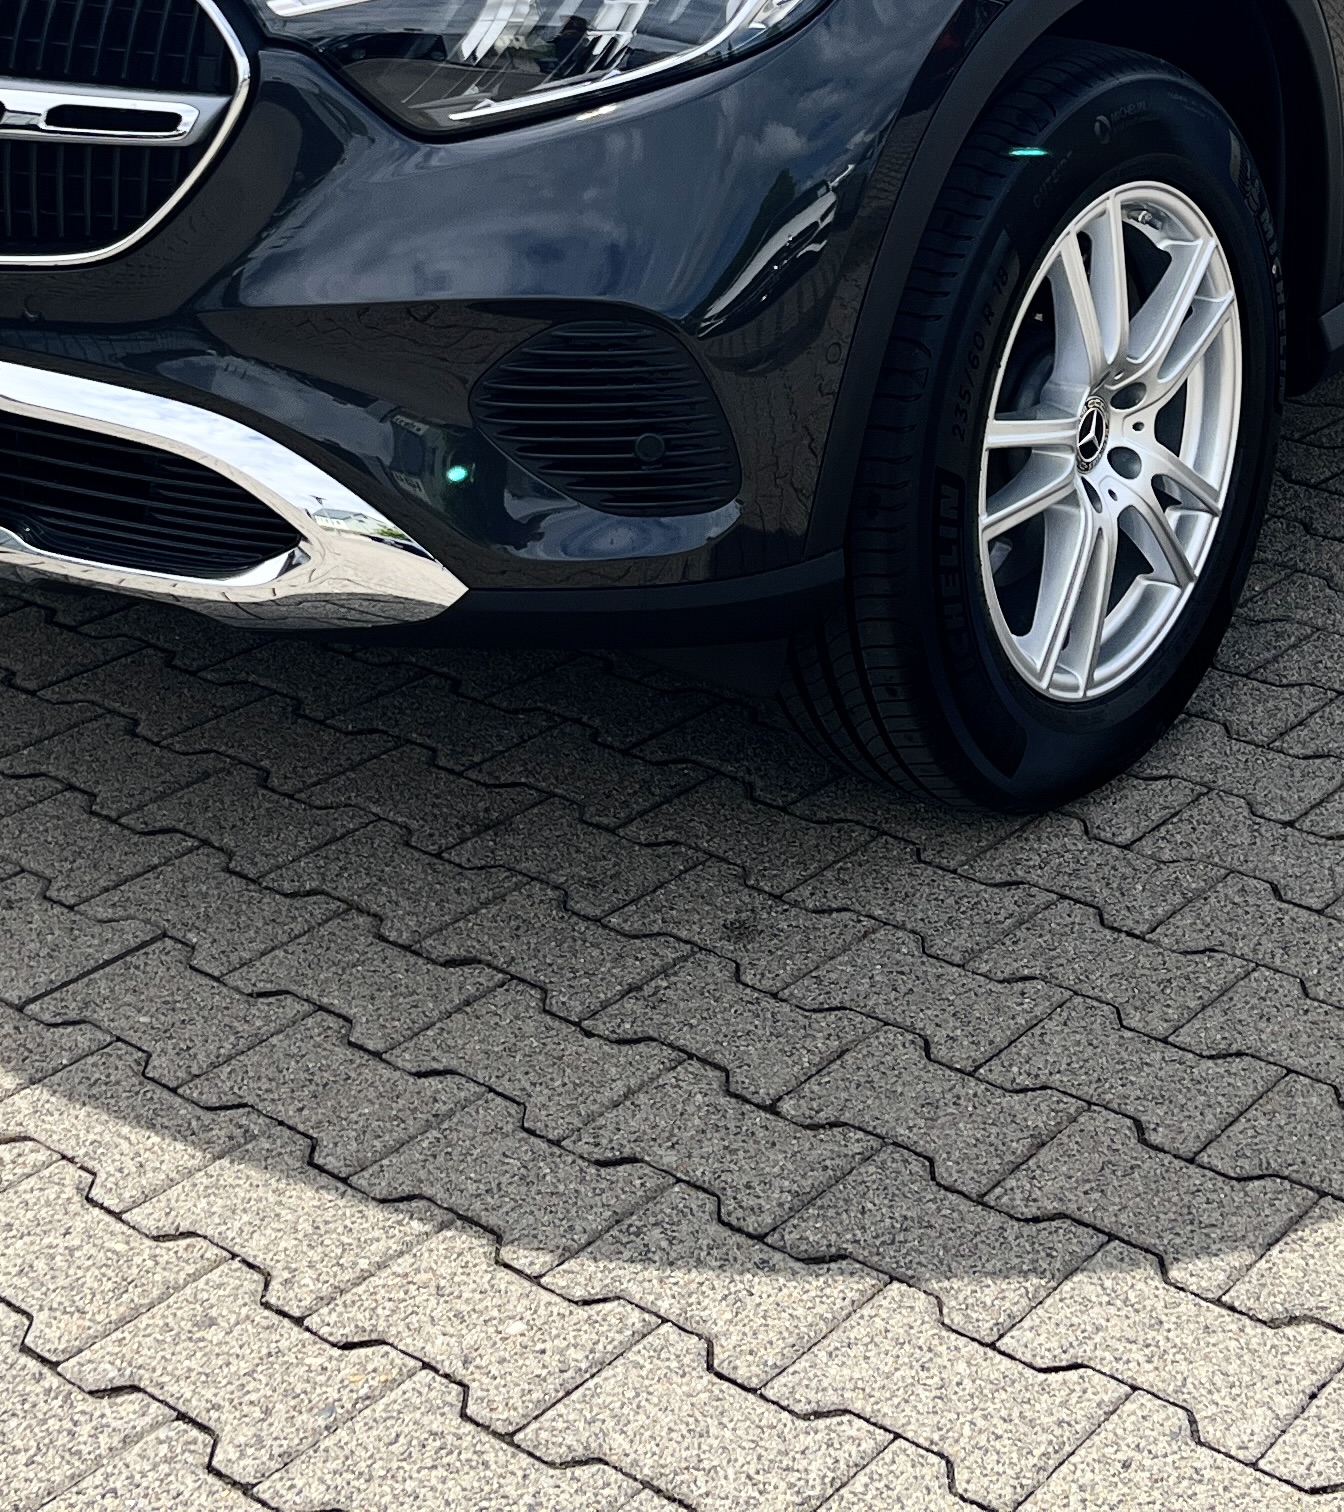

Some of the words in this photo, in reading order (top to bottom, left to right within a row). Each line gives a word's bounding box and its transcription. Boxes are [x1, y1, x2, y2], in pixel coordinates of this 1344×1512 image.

[952, 330, 986, 443] 235/60
[982, 301, 995, 326] R
[992, 264, 1009, 294] 18
[938, 483, 980, 678] ICHELIN
